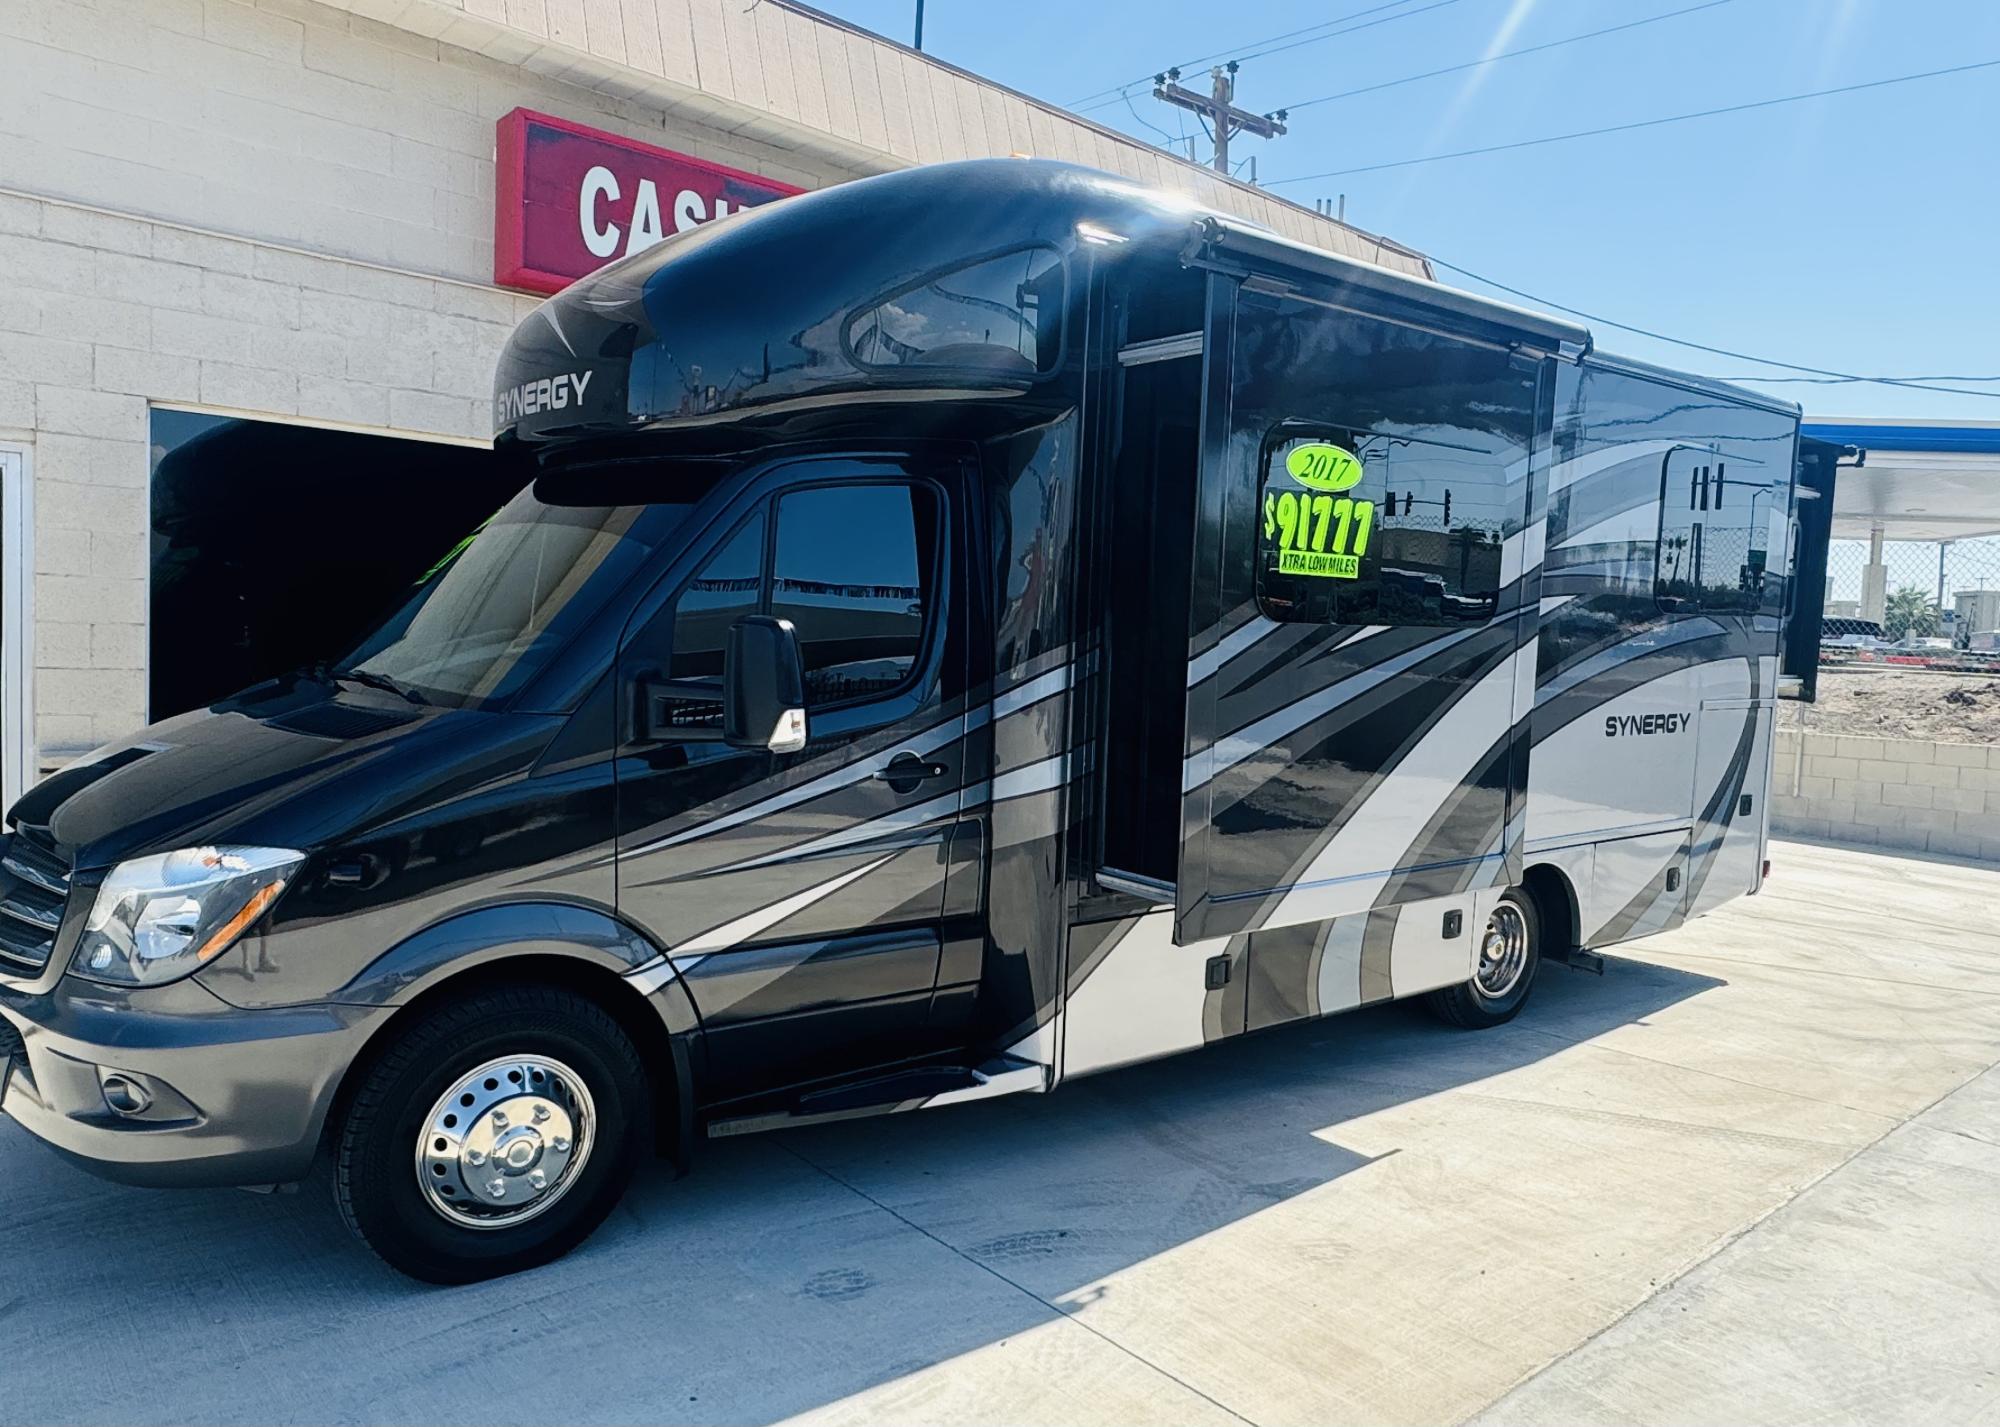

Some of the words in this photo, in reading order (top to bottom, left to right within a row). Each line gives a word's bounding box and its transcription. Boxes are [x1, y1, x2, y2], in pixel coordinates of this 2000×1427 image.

[580, 165, 752, 258] CAS
[498, 370, 592, 423] SYNERGY
[1299, 453, 1352, 482] 2017
[1265, 492, 1374, 556] $91777
[1282, 553, 1306, 570] XTRA
[1308, 556, 1328, 571] LOW
[1328, 557, 1357, 574] MILES
[1605, 712, 1691, 737] SYNERGY
